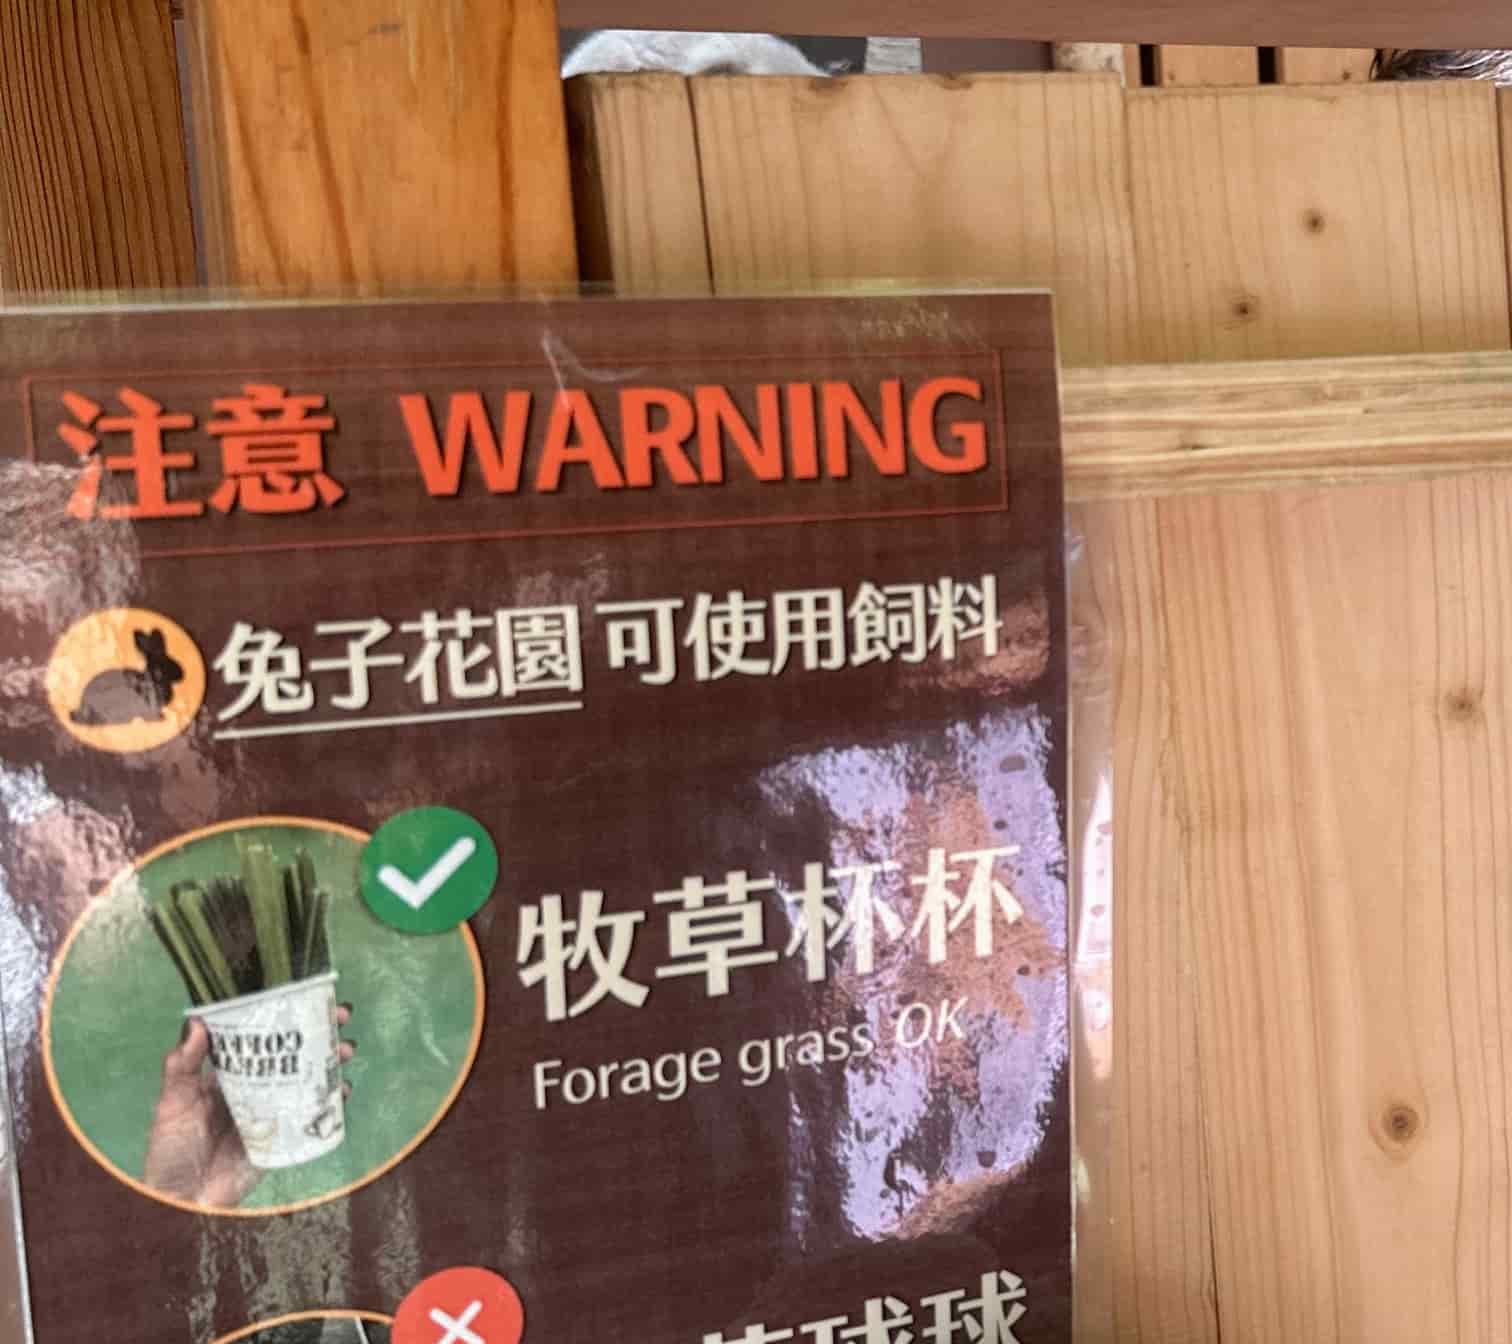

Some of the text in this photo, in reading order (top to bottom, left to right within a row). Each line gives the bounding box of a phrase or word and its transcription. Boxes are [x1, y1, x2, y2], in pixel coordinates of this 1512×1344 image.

[58, 375, 987, 523] 注意 WARNING
[213, 575, 1004, 721] 兔子花園 可使用飼料
[515, 844, 1025, 1022] 牧草杯杯
[533, 996, 968, 1110] Forage grass OK
